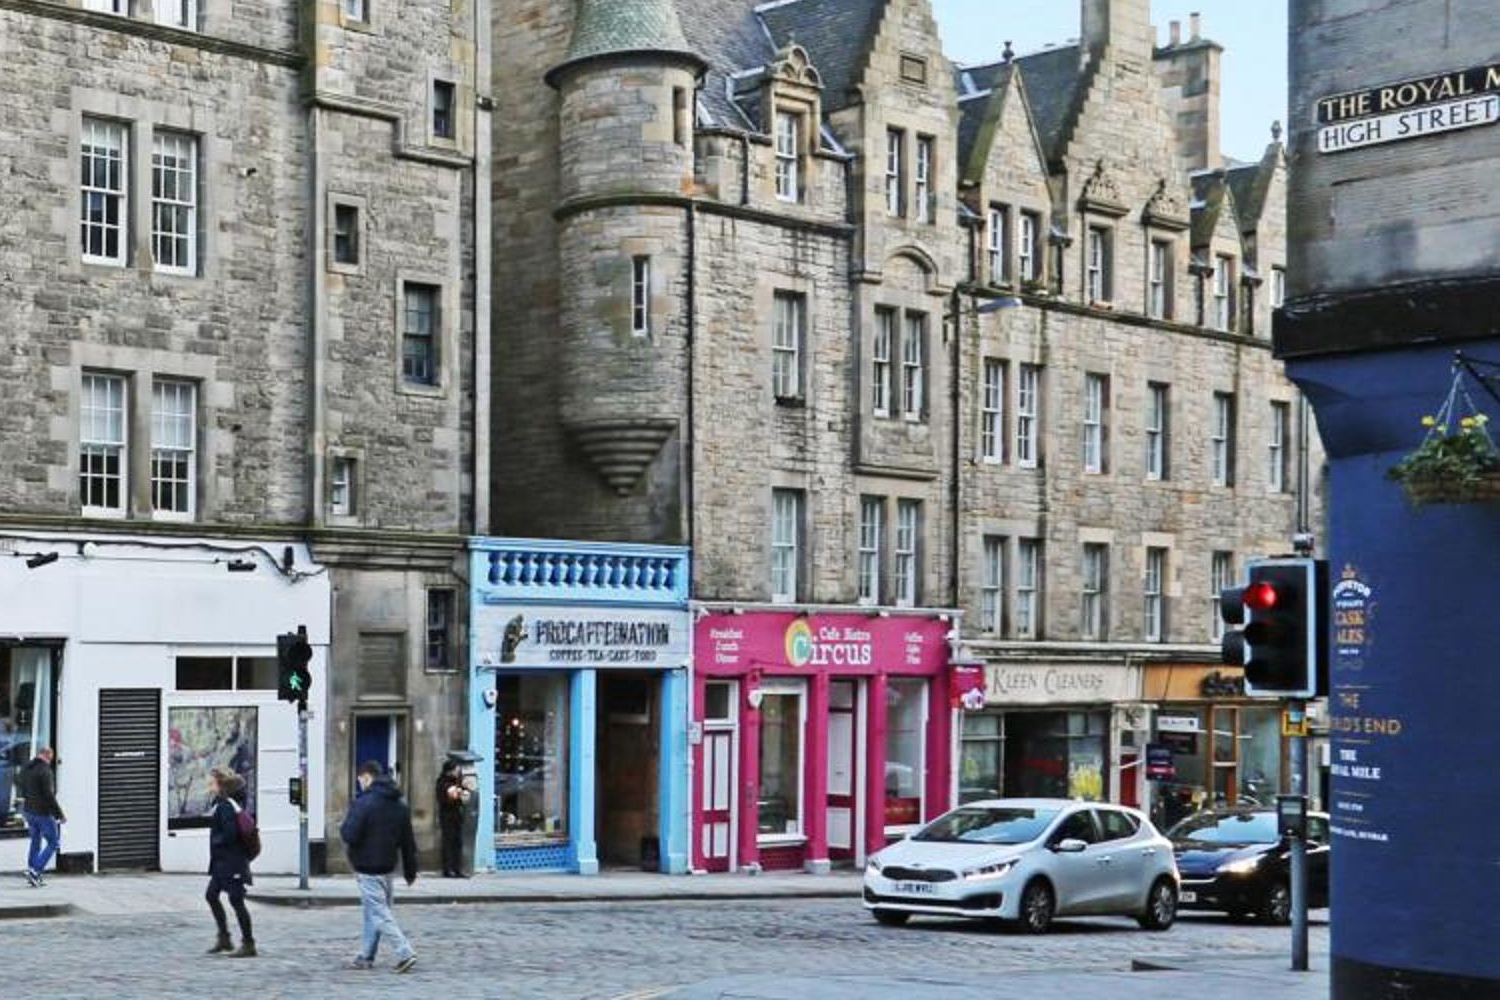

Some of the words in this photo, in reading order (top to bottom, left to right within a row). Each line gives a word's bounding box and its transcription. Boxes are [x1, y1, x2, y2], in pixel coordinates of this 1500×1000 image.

[1322, 92, 1373, 121] THE
[1380, 73, 1474, 110] ROYAL
[1324, 119, 1381, 149] HIGH
[1397, 99, 1496, 136] STREET
[536, 619, 670, 646] PROCAFFEINATION
[793, 633, 872, 666] Circus
[1339, 692, 1360, 709] THE
[1364, 718, 1402, 736] END
[1340, 749, 1357, 761] THE
[1352, 766, 1381, 780] MILE
